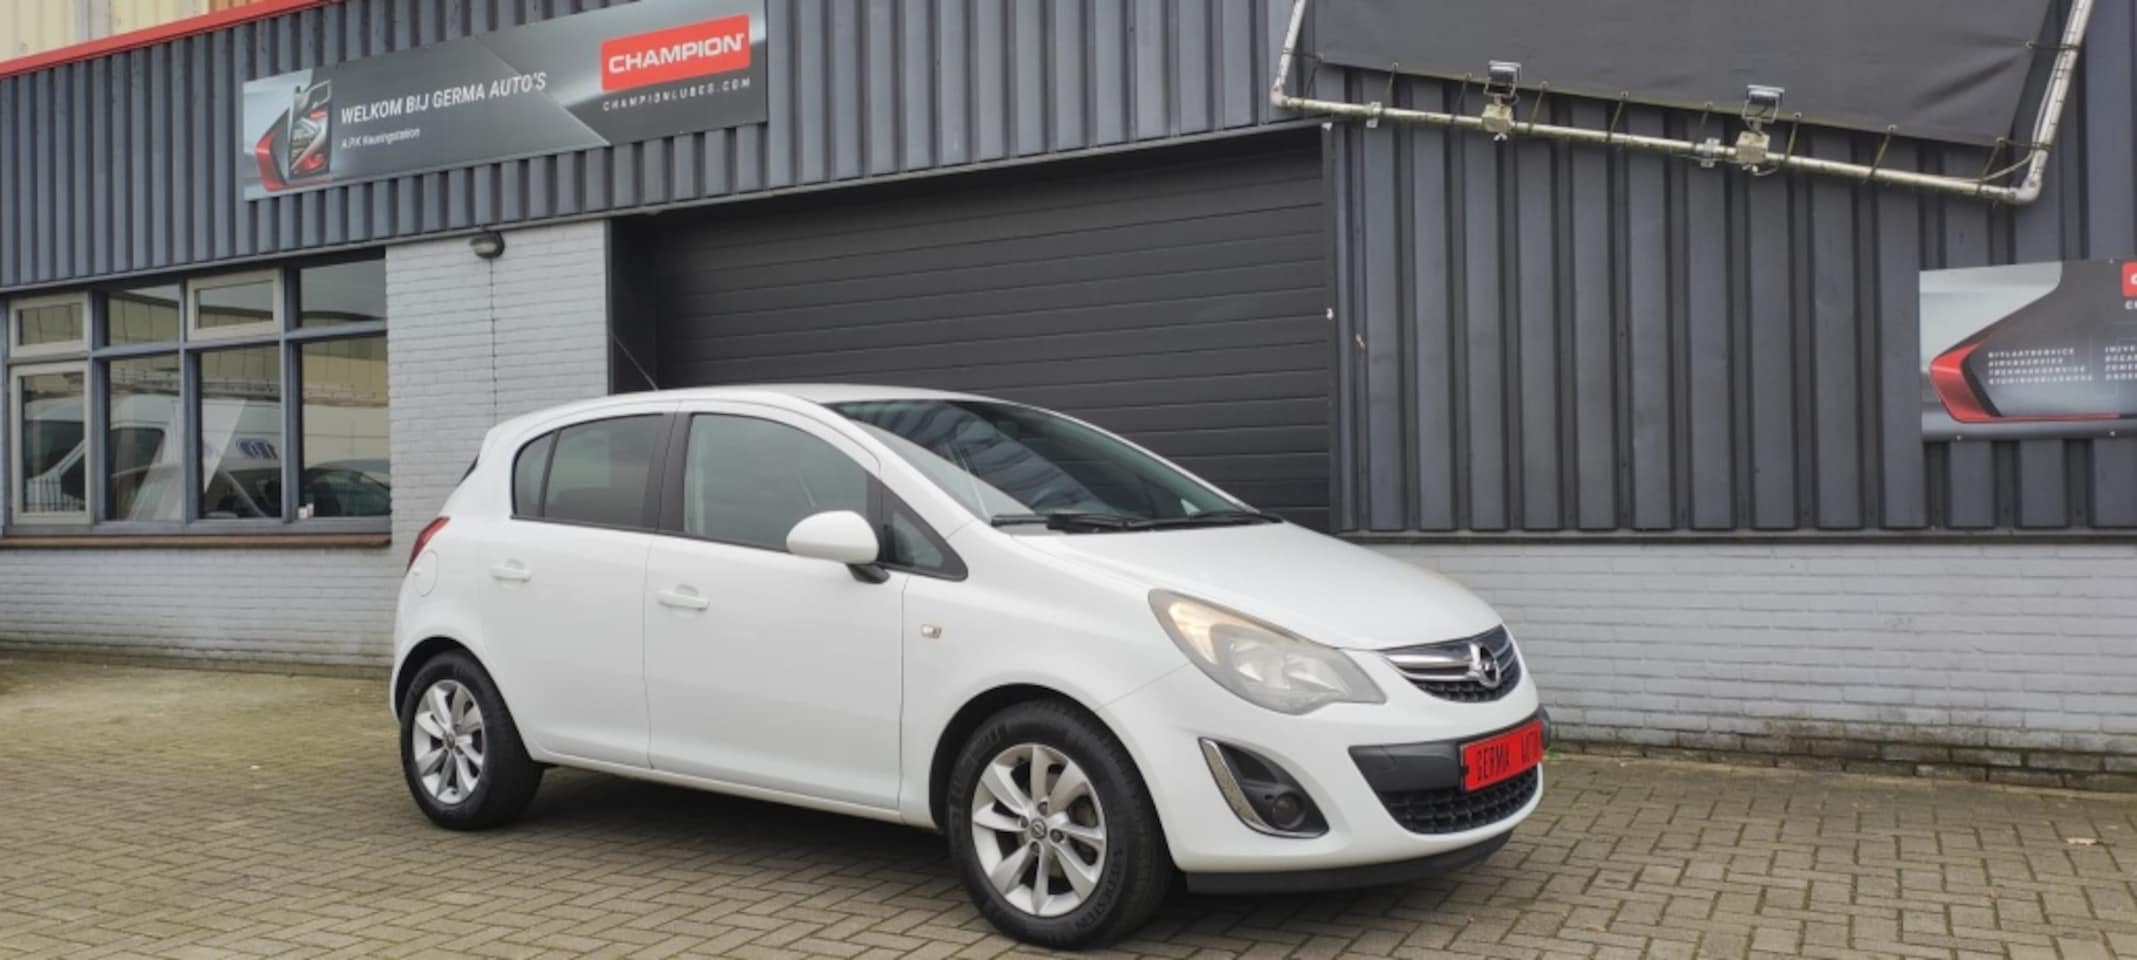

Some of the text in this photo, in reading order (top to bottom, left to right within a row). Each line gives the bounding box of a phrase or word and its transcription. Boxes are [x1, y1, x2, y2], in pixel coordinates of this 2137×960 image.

[608, 33, 744, 74] CHAMPION
[341, 72, 547, 124] WELKOM BIJ GERMA AUTO'S
[602, 77, 751, 111] CHAMPIONLUBES.COM
